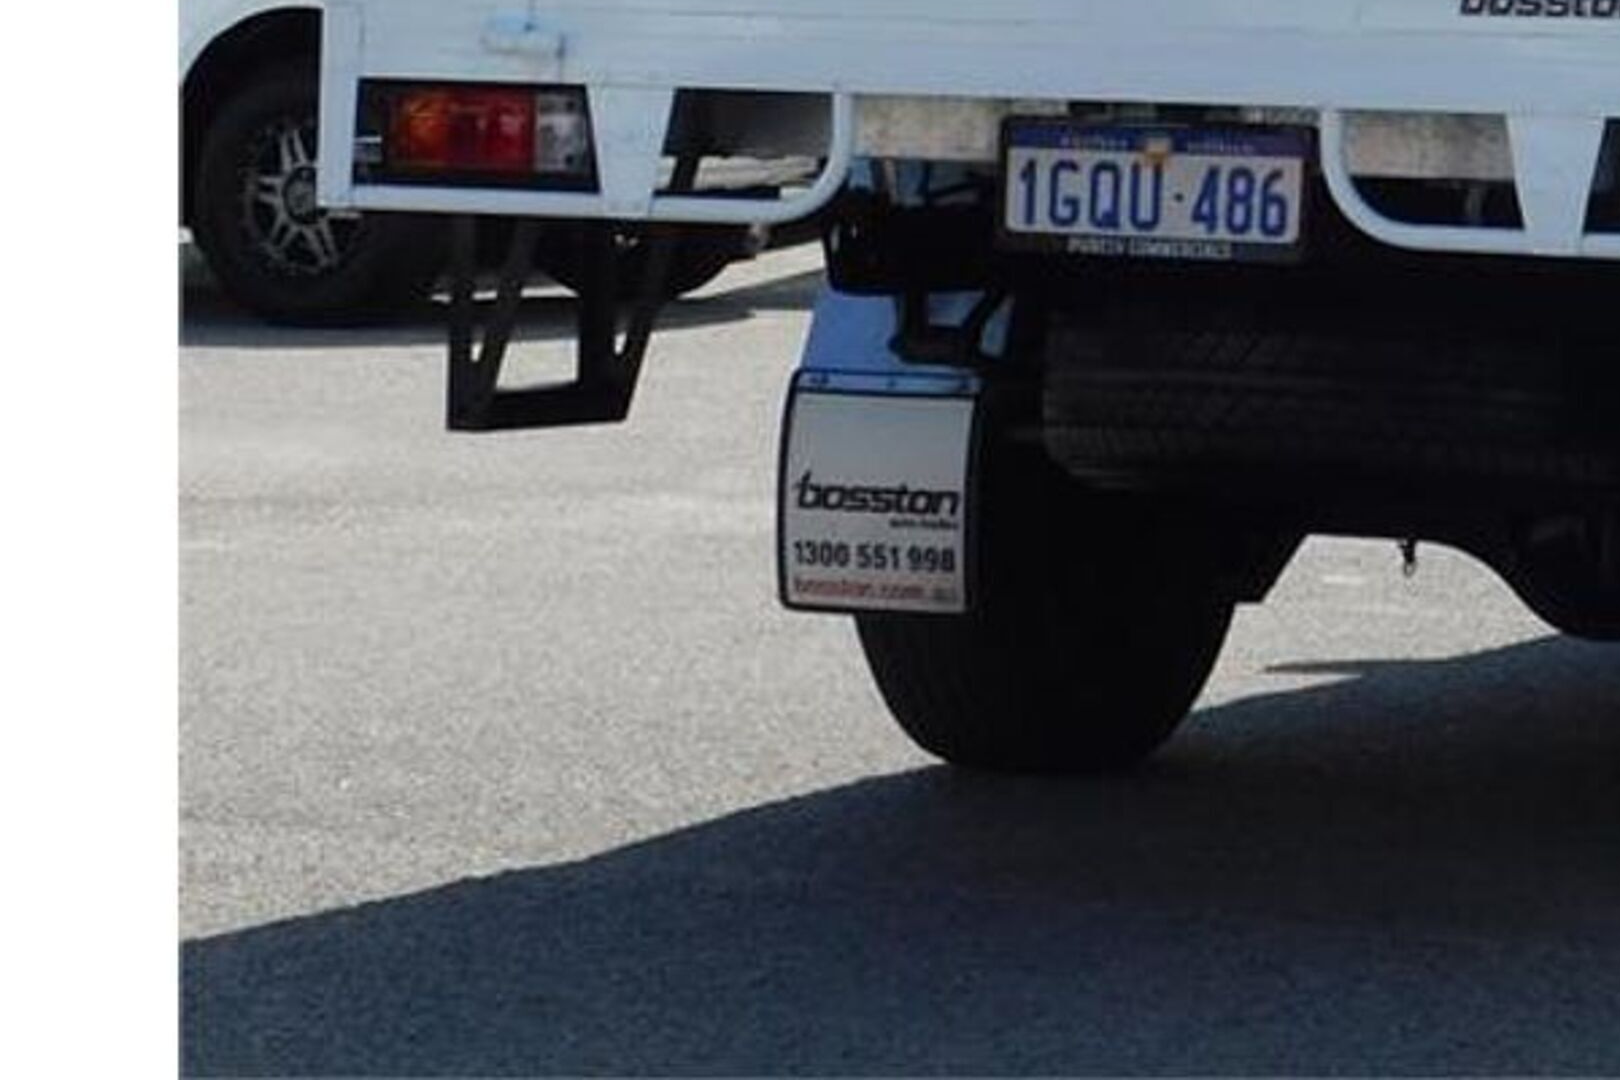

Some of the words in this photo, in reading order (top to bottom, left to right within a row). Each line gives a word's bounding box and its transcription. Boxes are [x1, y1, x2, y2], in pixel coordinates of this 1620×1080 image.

[795, 470, 961, 516] bosston
[793, 539, 849, 568] 1300
[857, 542, 901, 570] 551
[906, 545, 956, 572] 998
